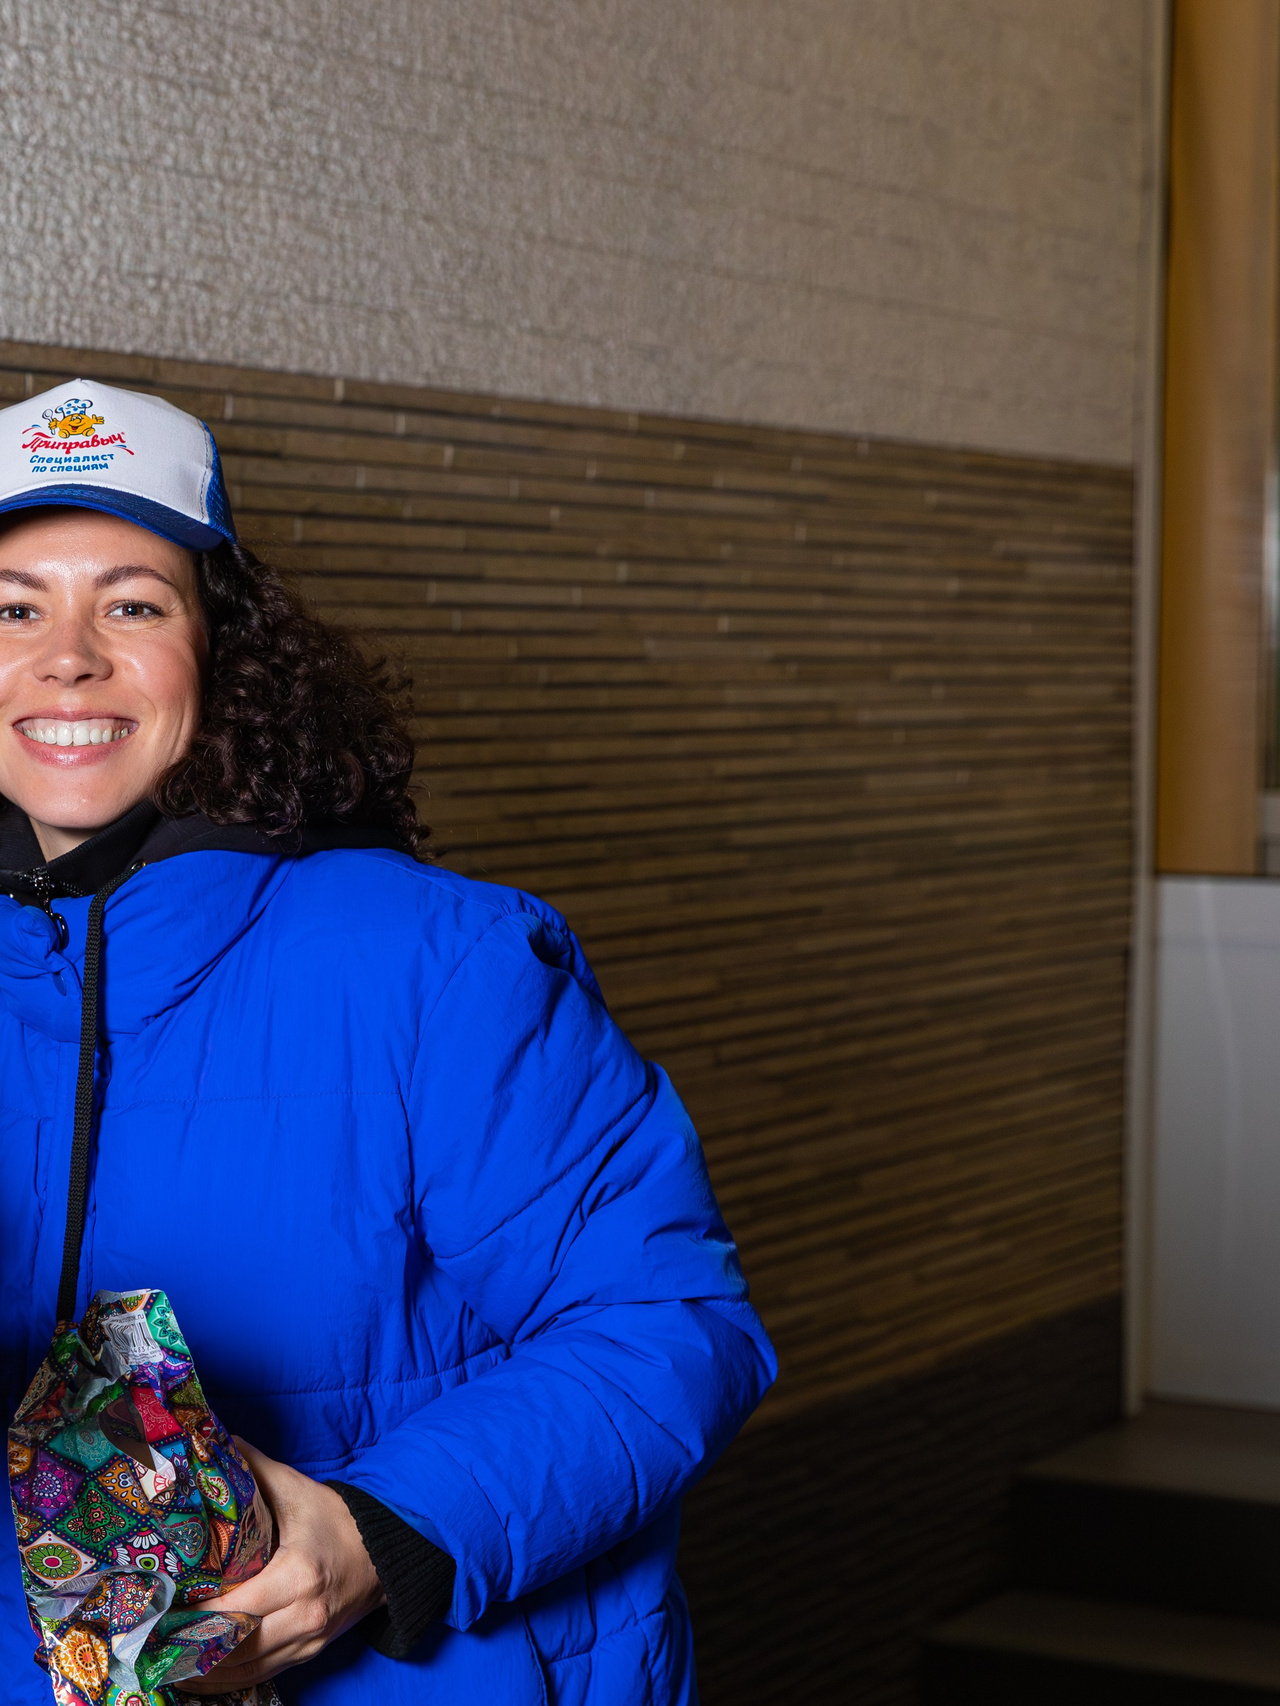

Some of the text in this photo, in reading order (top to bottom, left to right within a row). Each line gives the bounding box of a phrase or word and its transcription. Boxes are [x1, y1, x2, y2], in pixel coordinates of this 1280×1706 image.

[22, 432, 126, 455] Приправыч
[29, 453, 115, 465] Специалист
[31, 462, 109, 473] по специям
